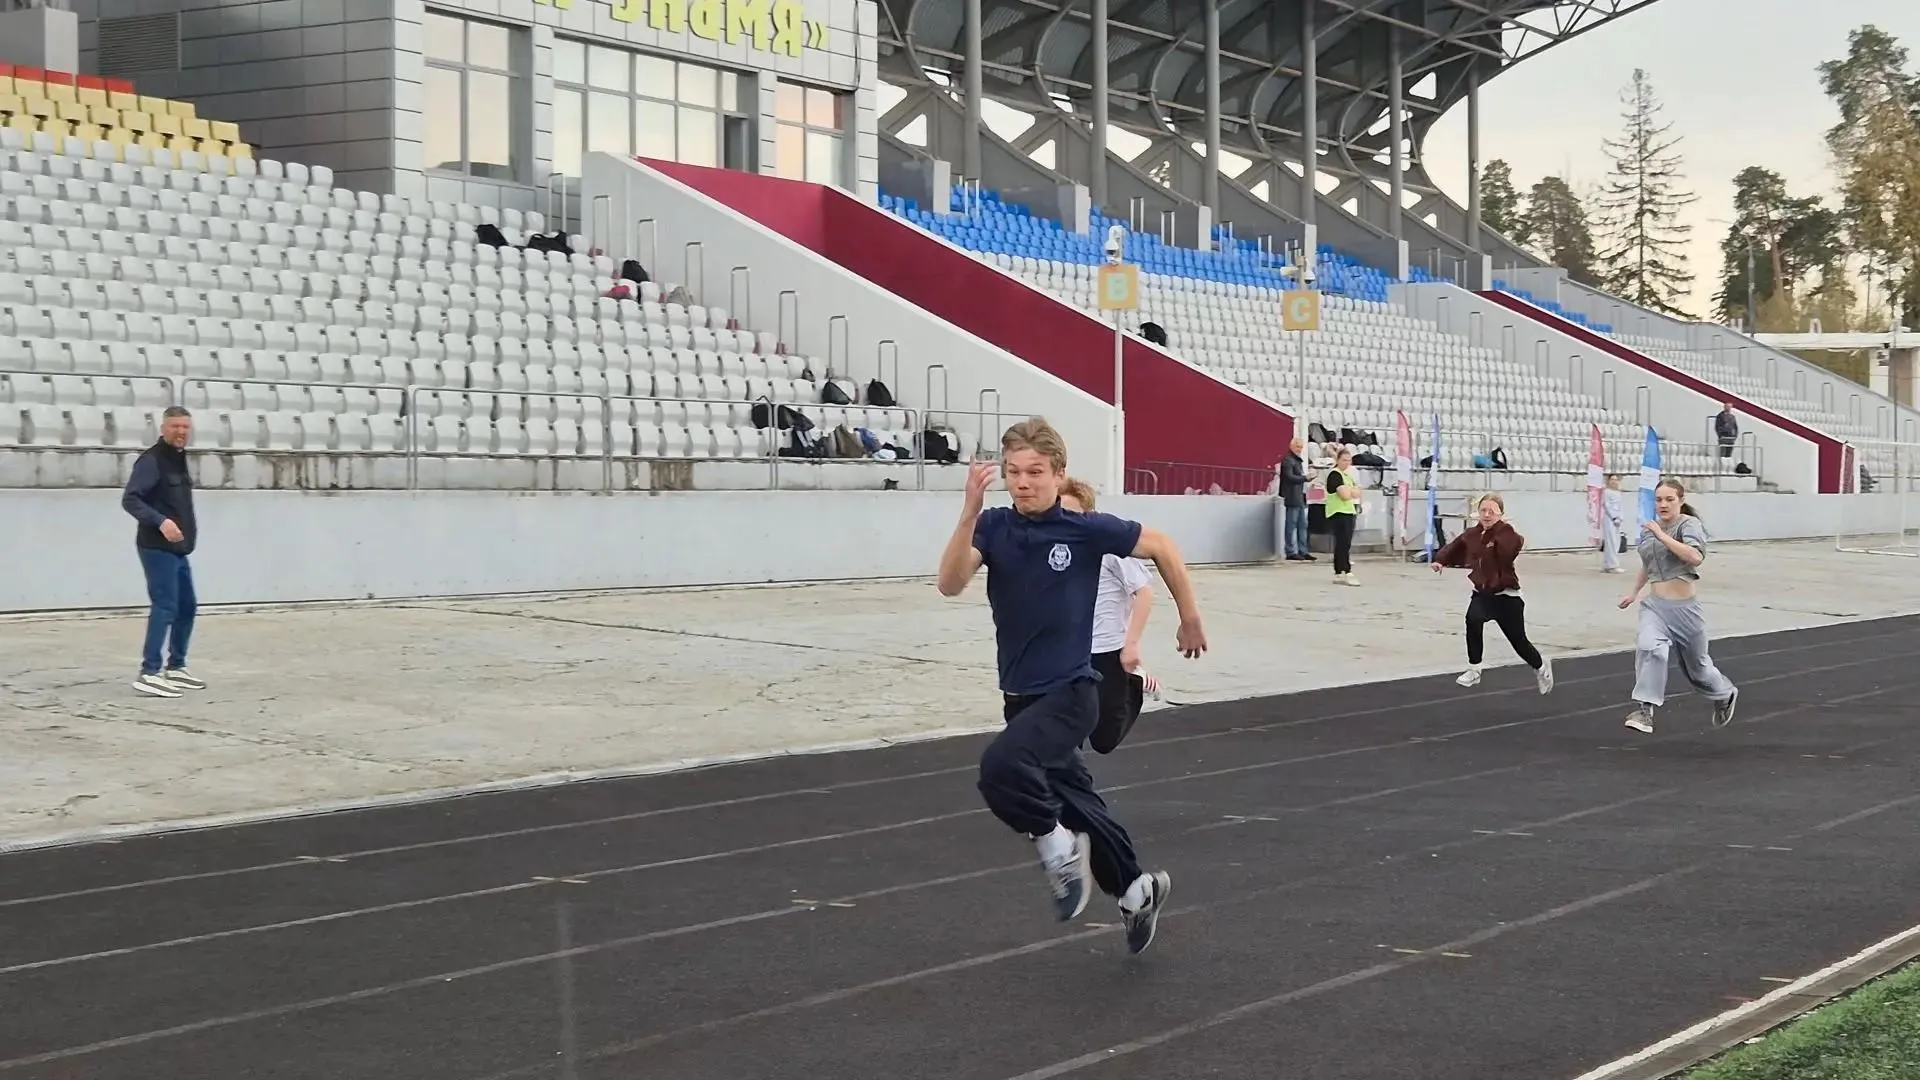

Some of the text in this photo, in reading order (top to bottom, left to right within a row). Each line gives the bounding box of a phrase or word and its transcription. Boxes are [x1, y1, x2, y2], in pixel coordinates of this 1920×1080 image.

[609, 0, 828, 58] амя»
[1107, 273, 1129, 301] B
[1291, 297, 1311, 323] C
